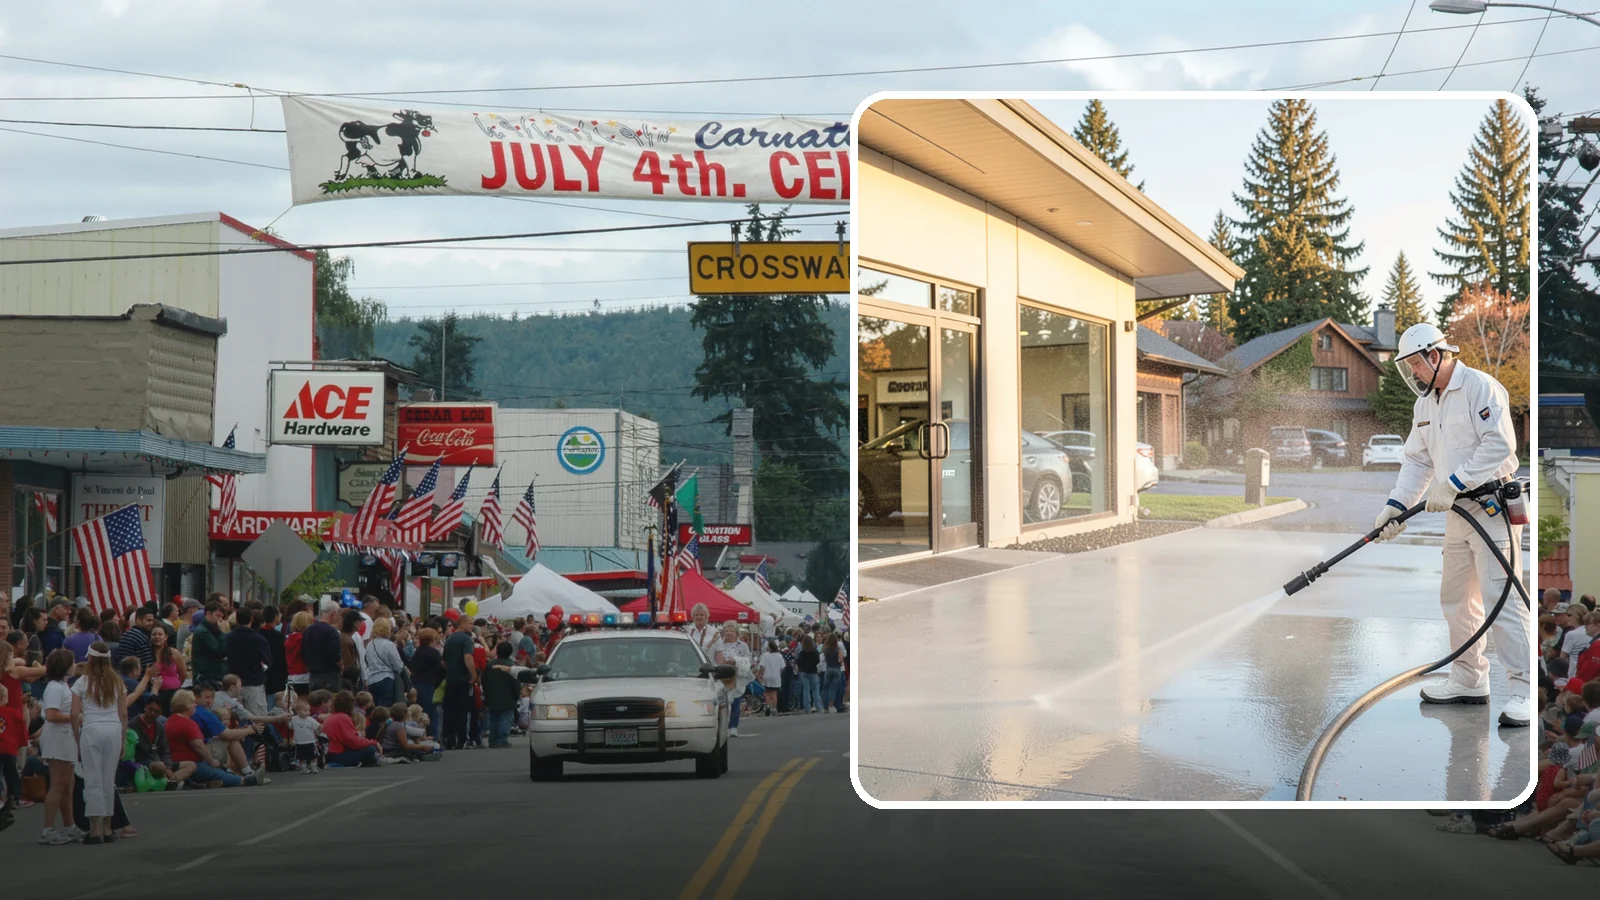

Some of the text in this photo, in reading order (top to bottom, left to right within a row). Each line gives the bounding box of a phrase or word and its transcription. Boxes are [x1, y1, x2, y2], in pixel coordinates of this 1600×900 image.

[481, 141, 604, 192] JULY
[632, 150, 746, 198] 4th.
[697, 254, 850, 280] CROSSWA
[283, 380, 373, 420] ACE
[283, 421, 371, 437] Hardware
[416, 428, 477, 447] Coca-Cola
[96, 485, 124, 494] Vincent
[126, 486, 135, 495] de
[138, 486, 155, 495] Paul
[688, 526, 741, 535] CRNATION
